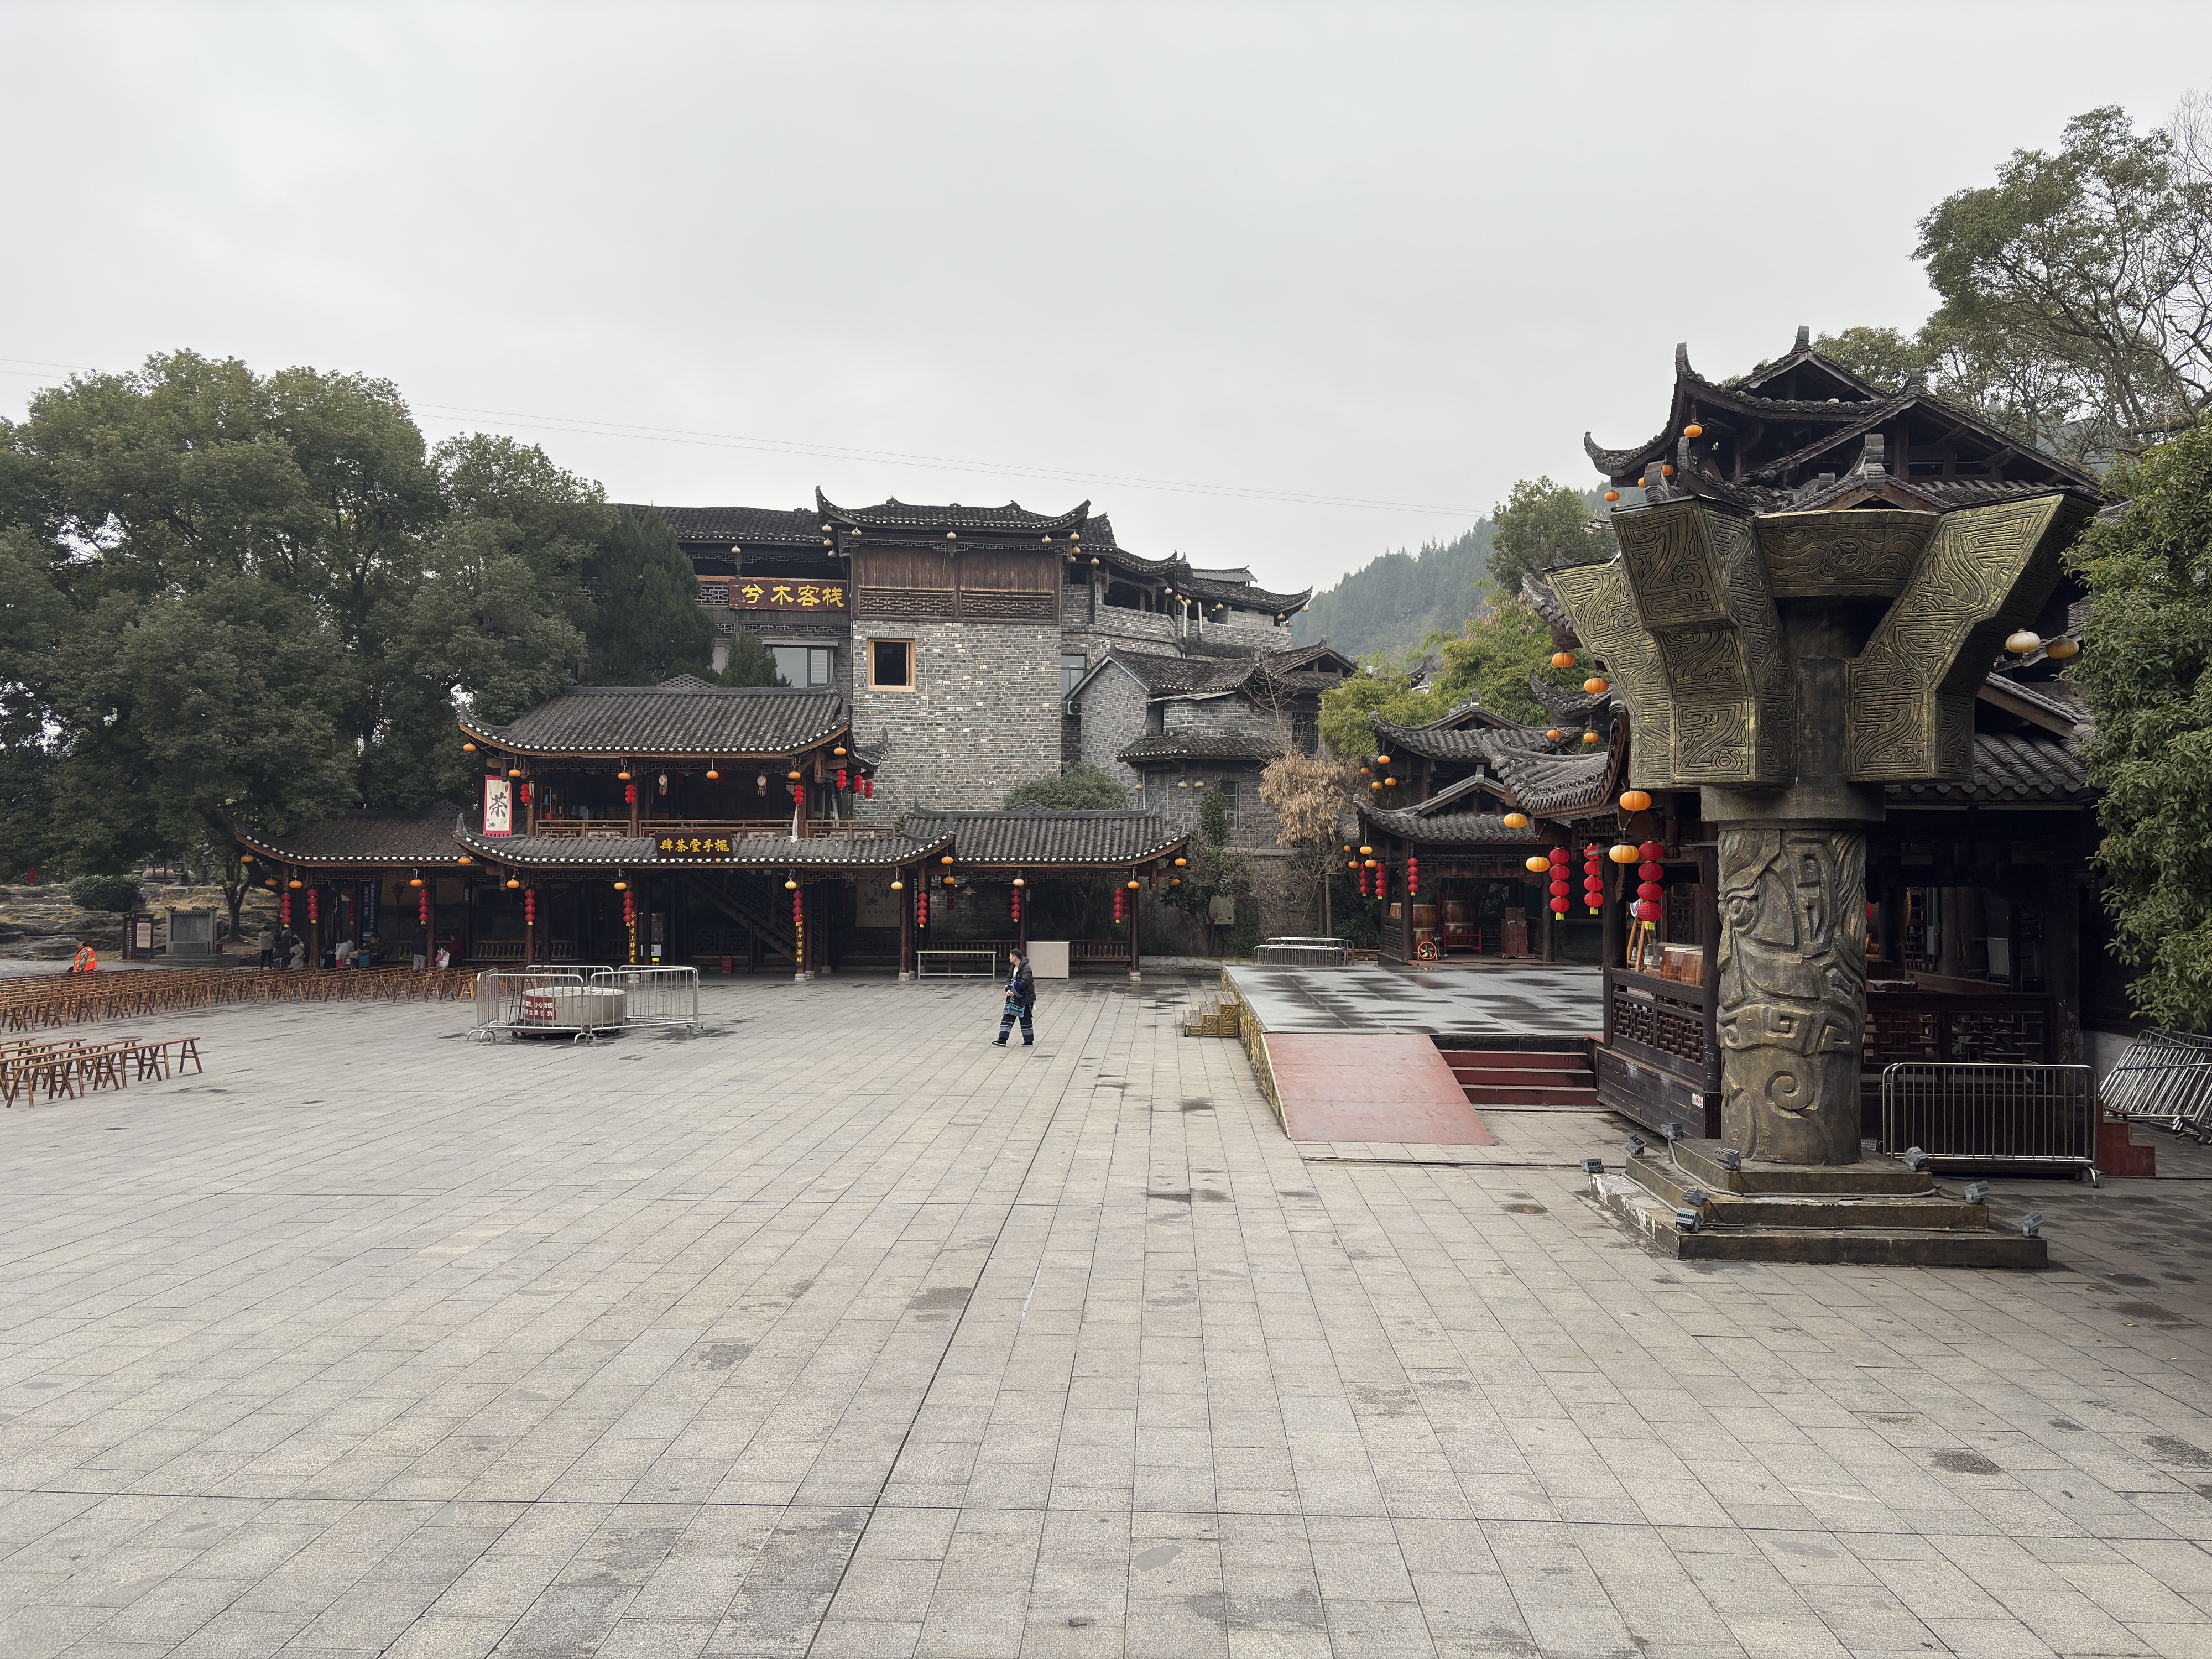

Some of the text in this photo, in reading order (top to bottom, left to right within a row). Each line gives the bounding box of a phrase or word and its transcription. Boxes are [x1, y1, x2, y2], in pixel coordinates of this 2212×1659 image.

[741, 583, 845, 608] 兮木客栈
[489, 792, 508, 817] 茶
